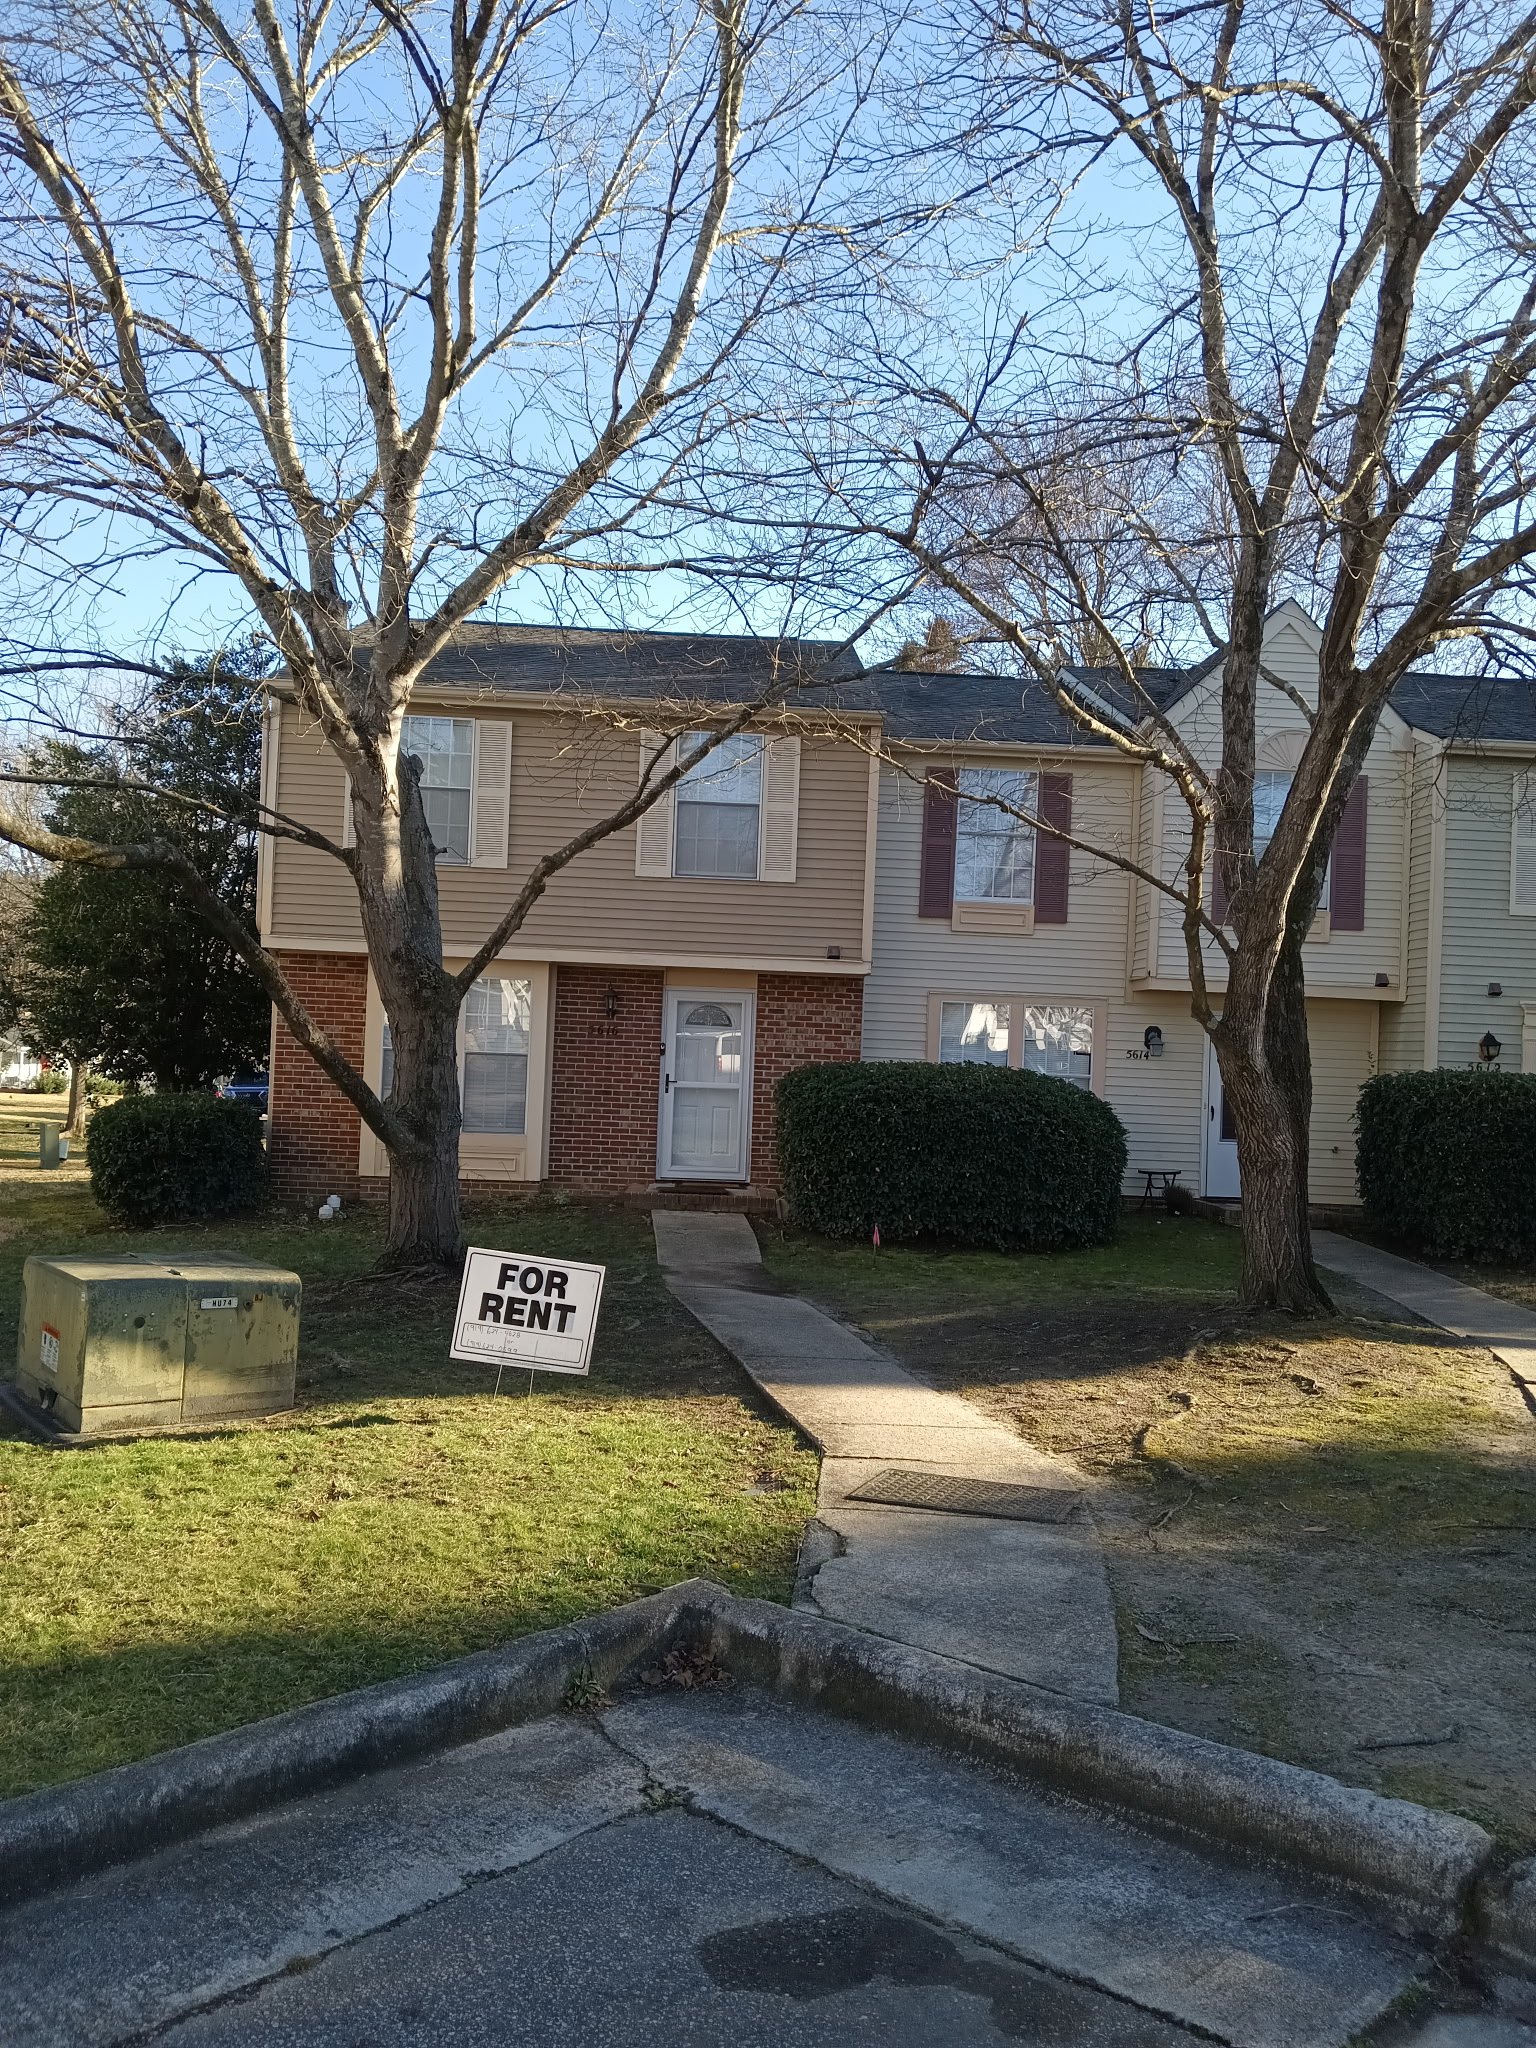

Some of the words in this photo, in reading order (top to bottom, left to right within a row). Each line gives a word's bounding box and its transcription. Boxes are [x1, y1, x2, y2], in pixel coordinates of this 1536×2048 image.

[1126, 1050, 1150, 1060] 5614
[496, 1262, 569, 1299] FOR
[478, 1292, 577, 1333] RENT
